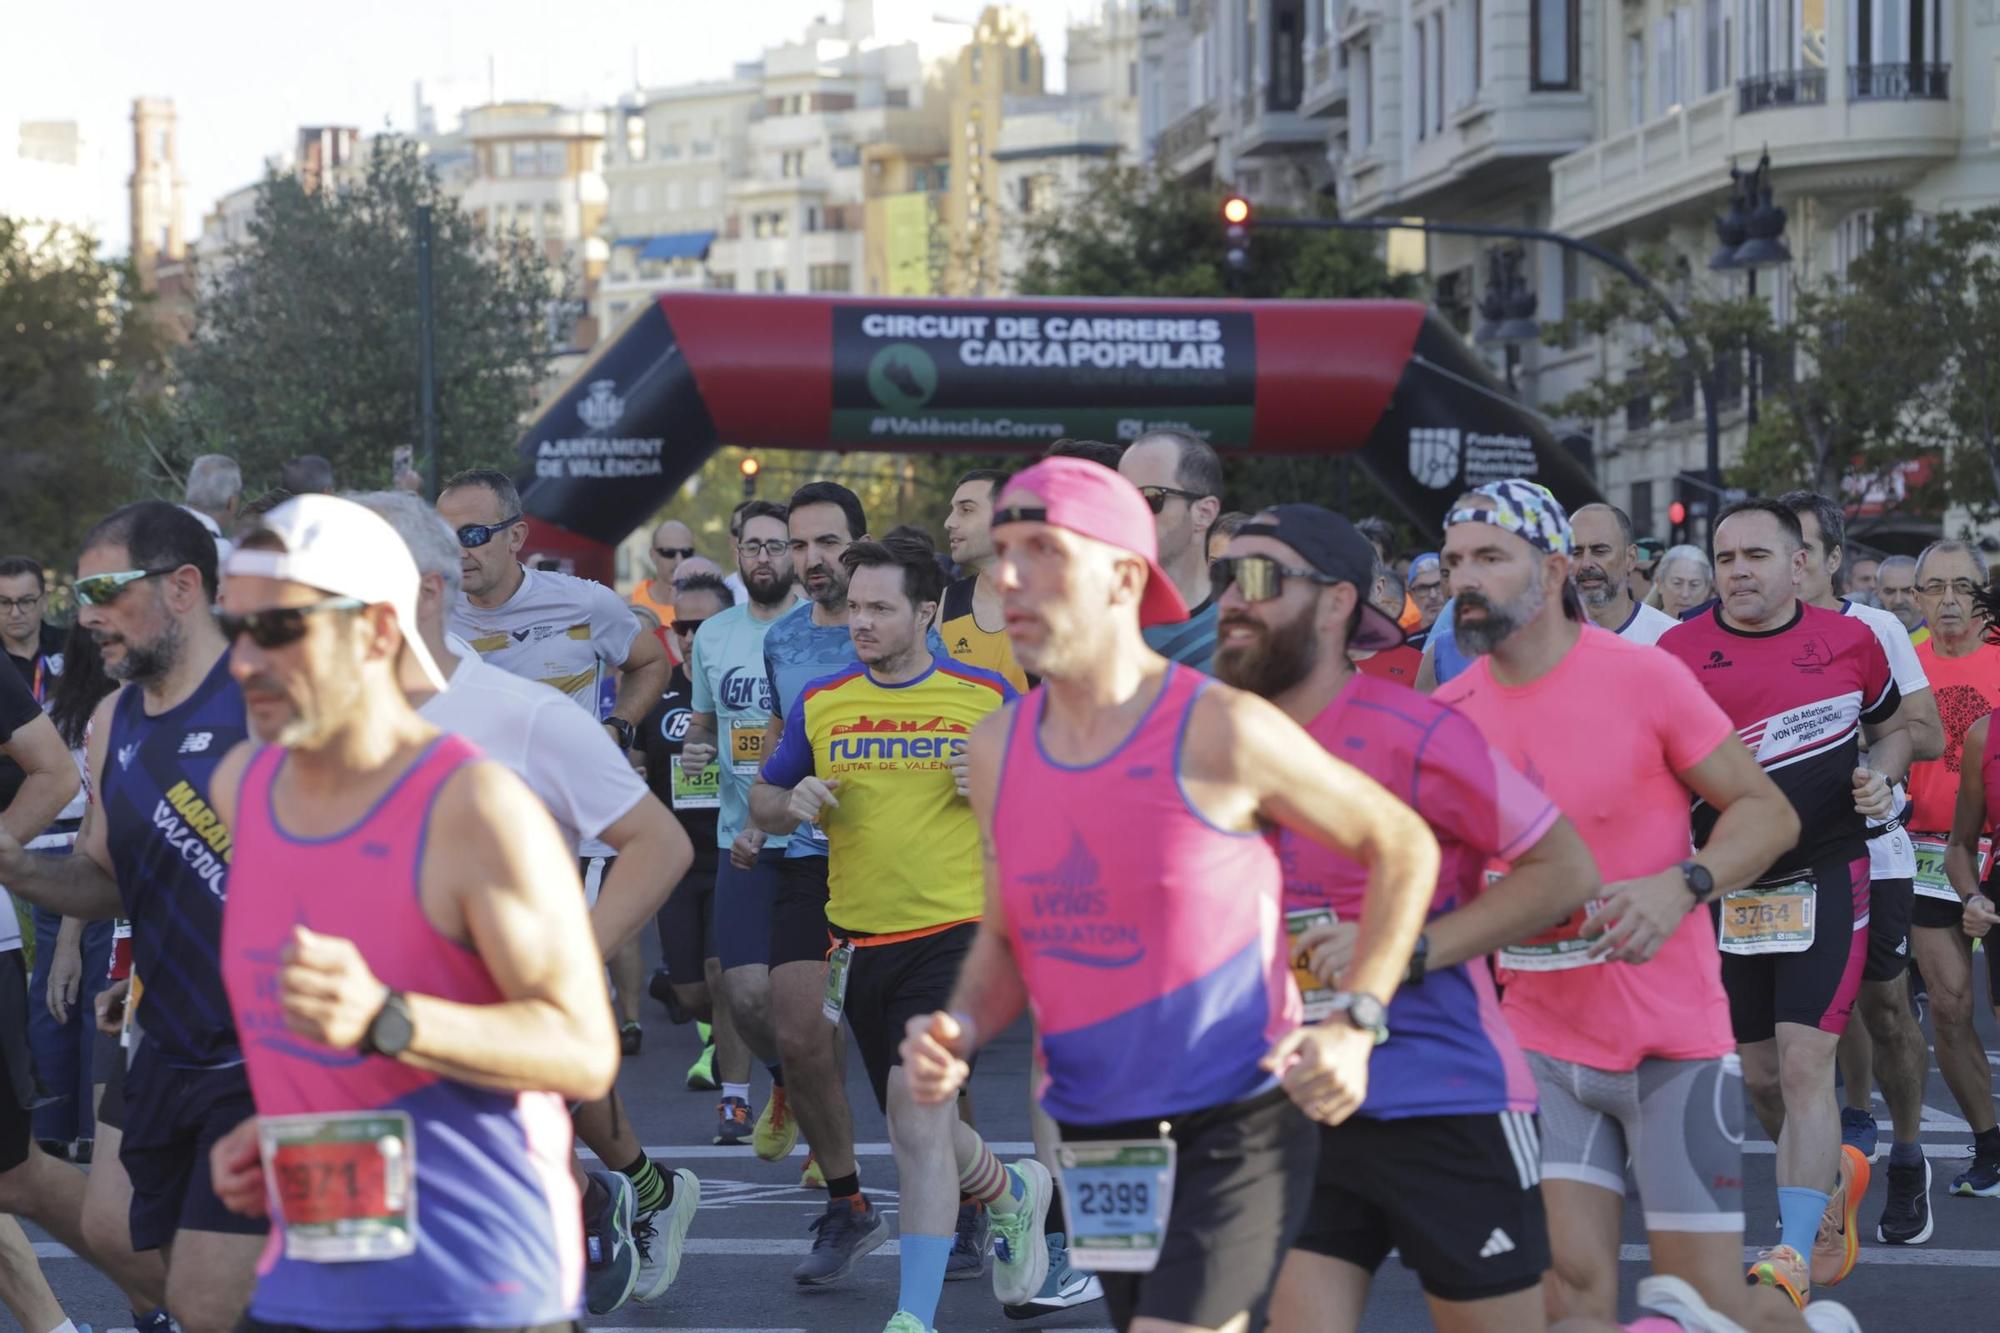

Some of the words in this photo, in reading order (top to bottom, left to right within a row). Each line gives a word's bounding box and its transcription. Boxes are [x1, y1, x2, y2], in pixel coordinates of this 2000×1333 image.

[863, 314, 988, 338] CIRCUIT
[995, 317, 1040, 339] DE
[1044, 318, 1221, 342] CARRERES
[537, 437, 664, 457] AJUNTAMENT
[536, 459, 562, 477] DE
[568, 458, 662, 477] VALÈNCIA
[724, 677, 756, 703] 15K
[1772, 730, 1790, 741] VON
[1791, 711, 1842, 732] HIPPEL-LINDAU
[1783, 714, 1799, 725] Club
[1801, 705, 1833, 719] Atletismo
[738, 735, 765, 751] 39
[830, 736, 968, 761] runners
[832, 762, 872, 773] CIUTAT
[879, 762, 899, 770] DE
[1735, 903, 1790, 925] 3764
[1077, 1182, 1149, 1215] 2399
